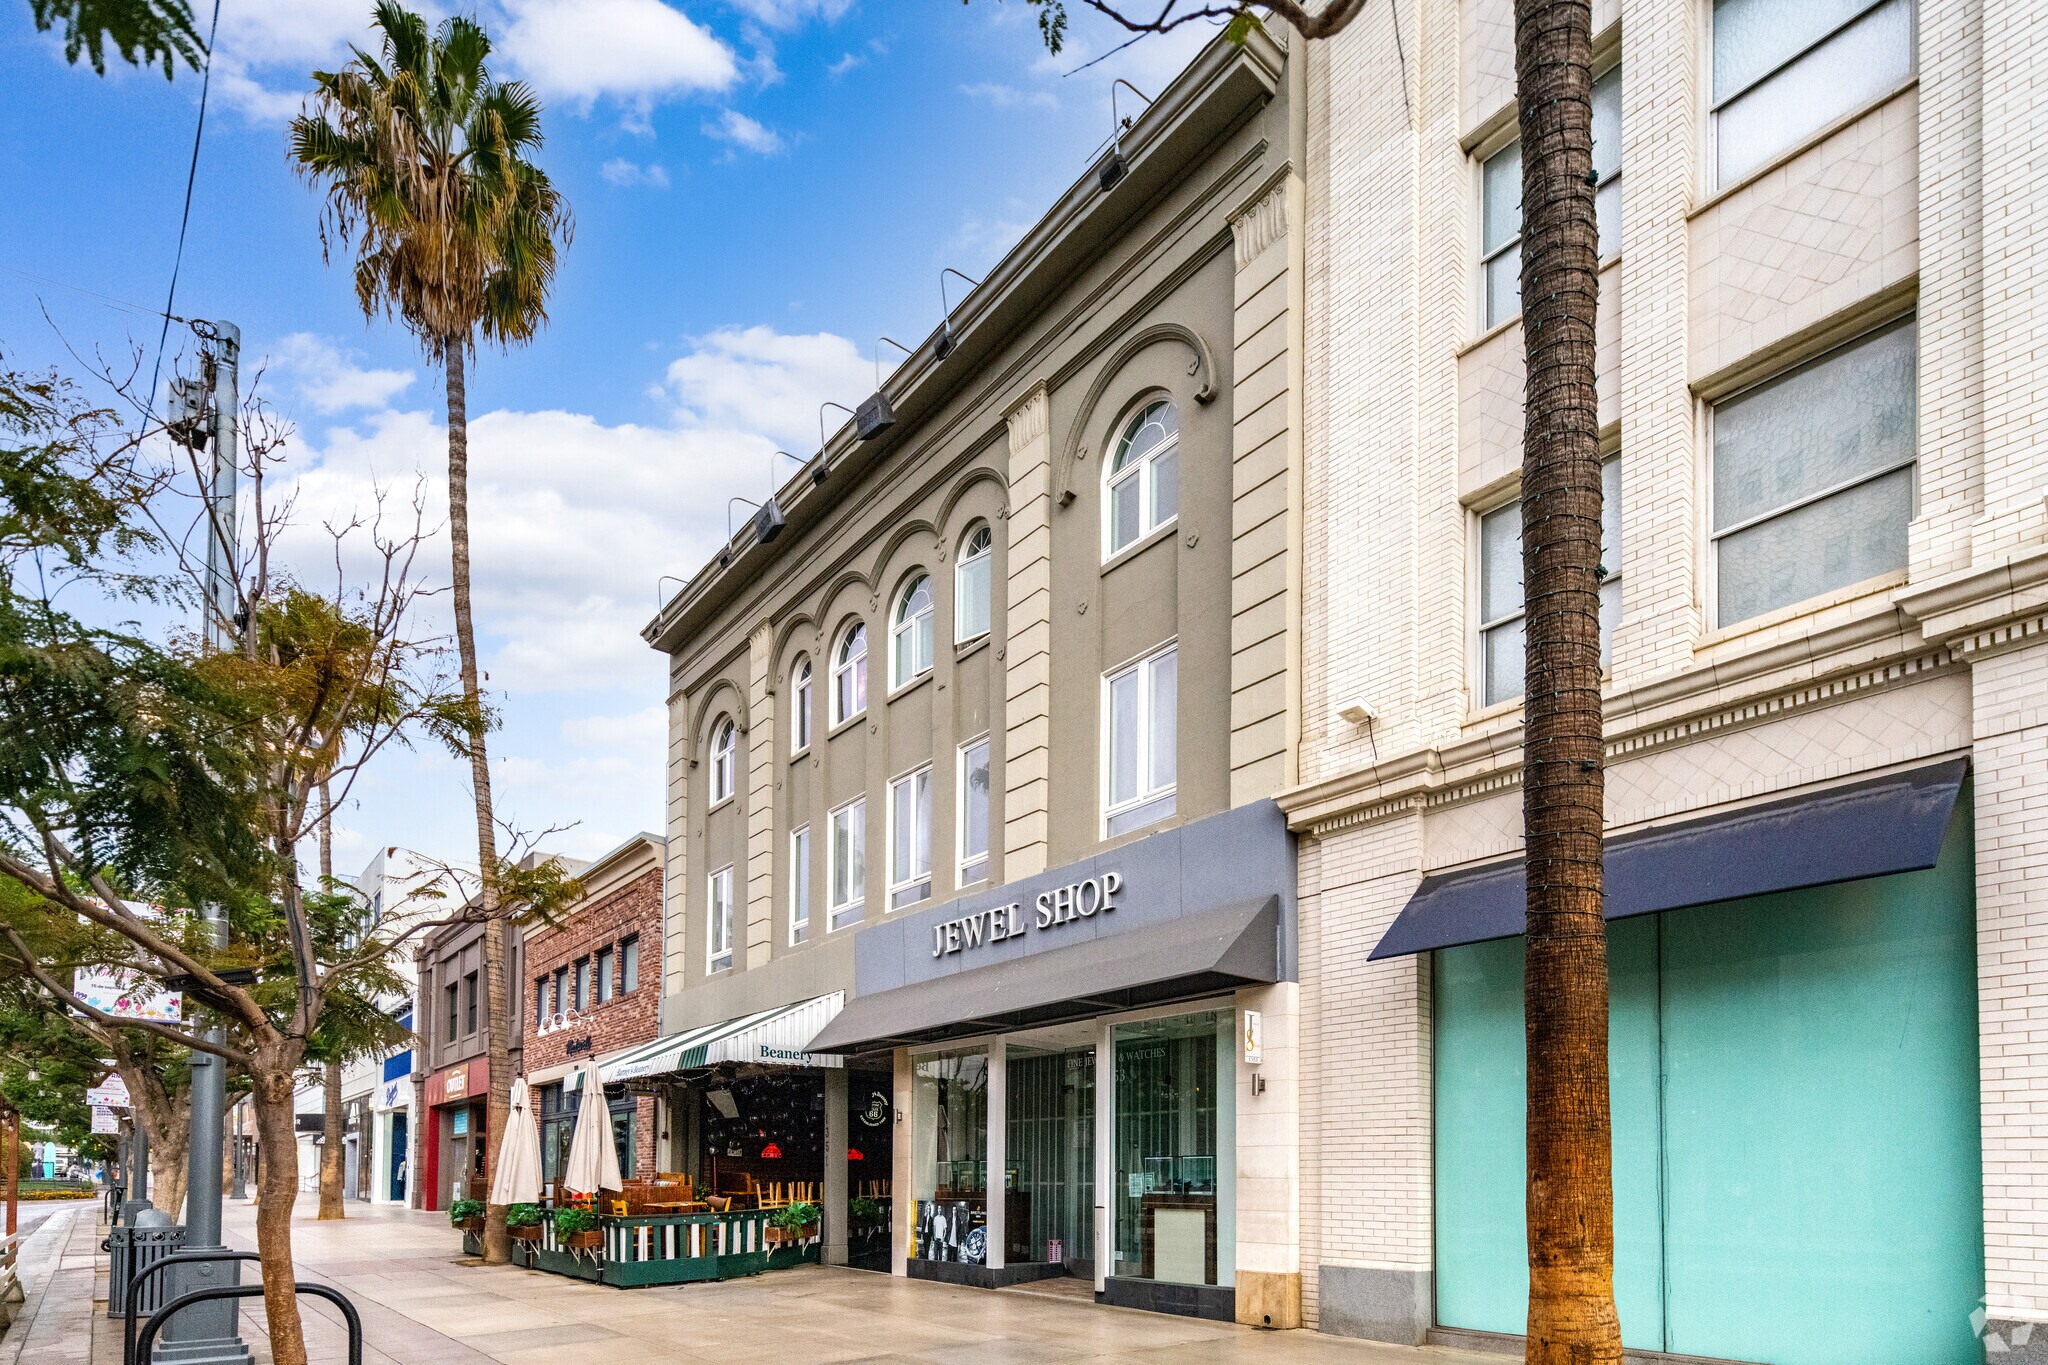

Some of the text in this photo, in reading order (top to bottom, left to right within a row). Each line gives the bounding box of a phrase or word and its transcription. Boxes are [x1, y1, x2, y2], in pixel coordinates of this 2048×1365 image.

[933, 871, 1124, 958] JEWEL SHOP
[760, 1045, 813, 1063] Beanery
[1067, 1057, 1083, 1068] FINE
[1119, 1047, 1166, 1062] & WATCHES
[447, 1074, 466, 1094] OUTLET
